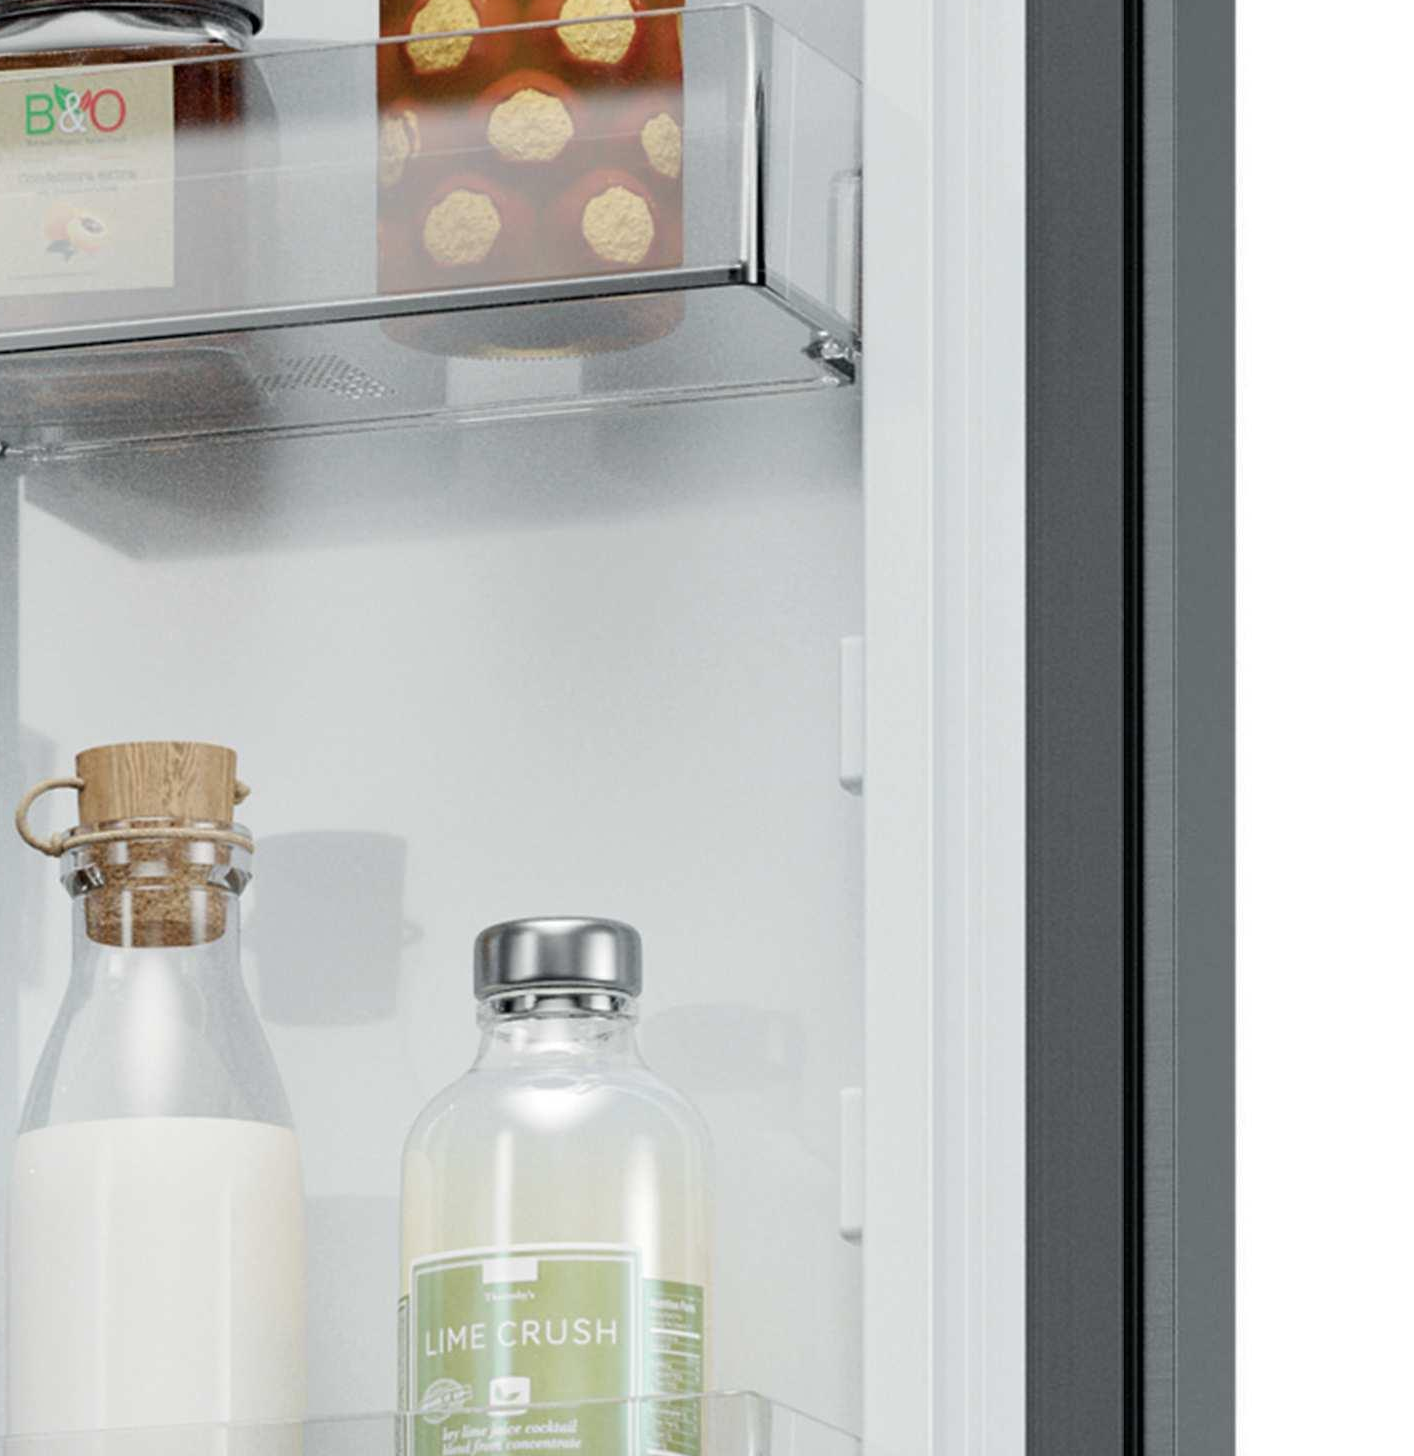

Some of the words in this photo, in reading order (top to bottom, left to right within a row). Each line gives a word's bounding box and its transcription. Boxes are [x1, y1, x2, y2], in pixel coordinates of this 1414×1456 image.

[26, 88, 126, 135] B&O
[425, 1323, 486, 1356] LIME
[497, 1317, 617, 1347] CRUSH
